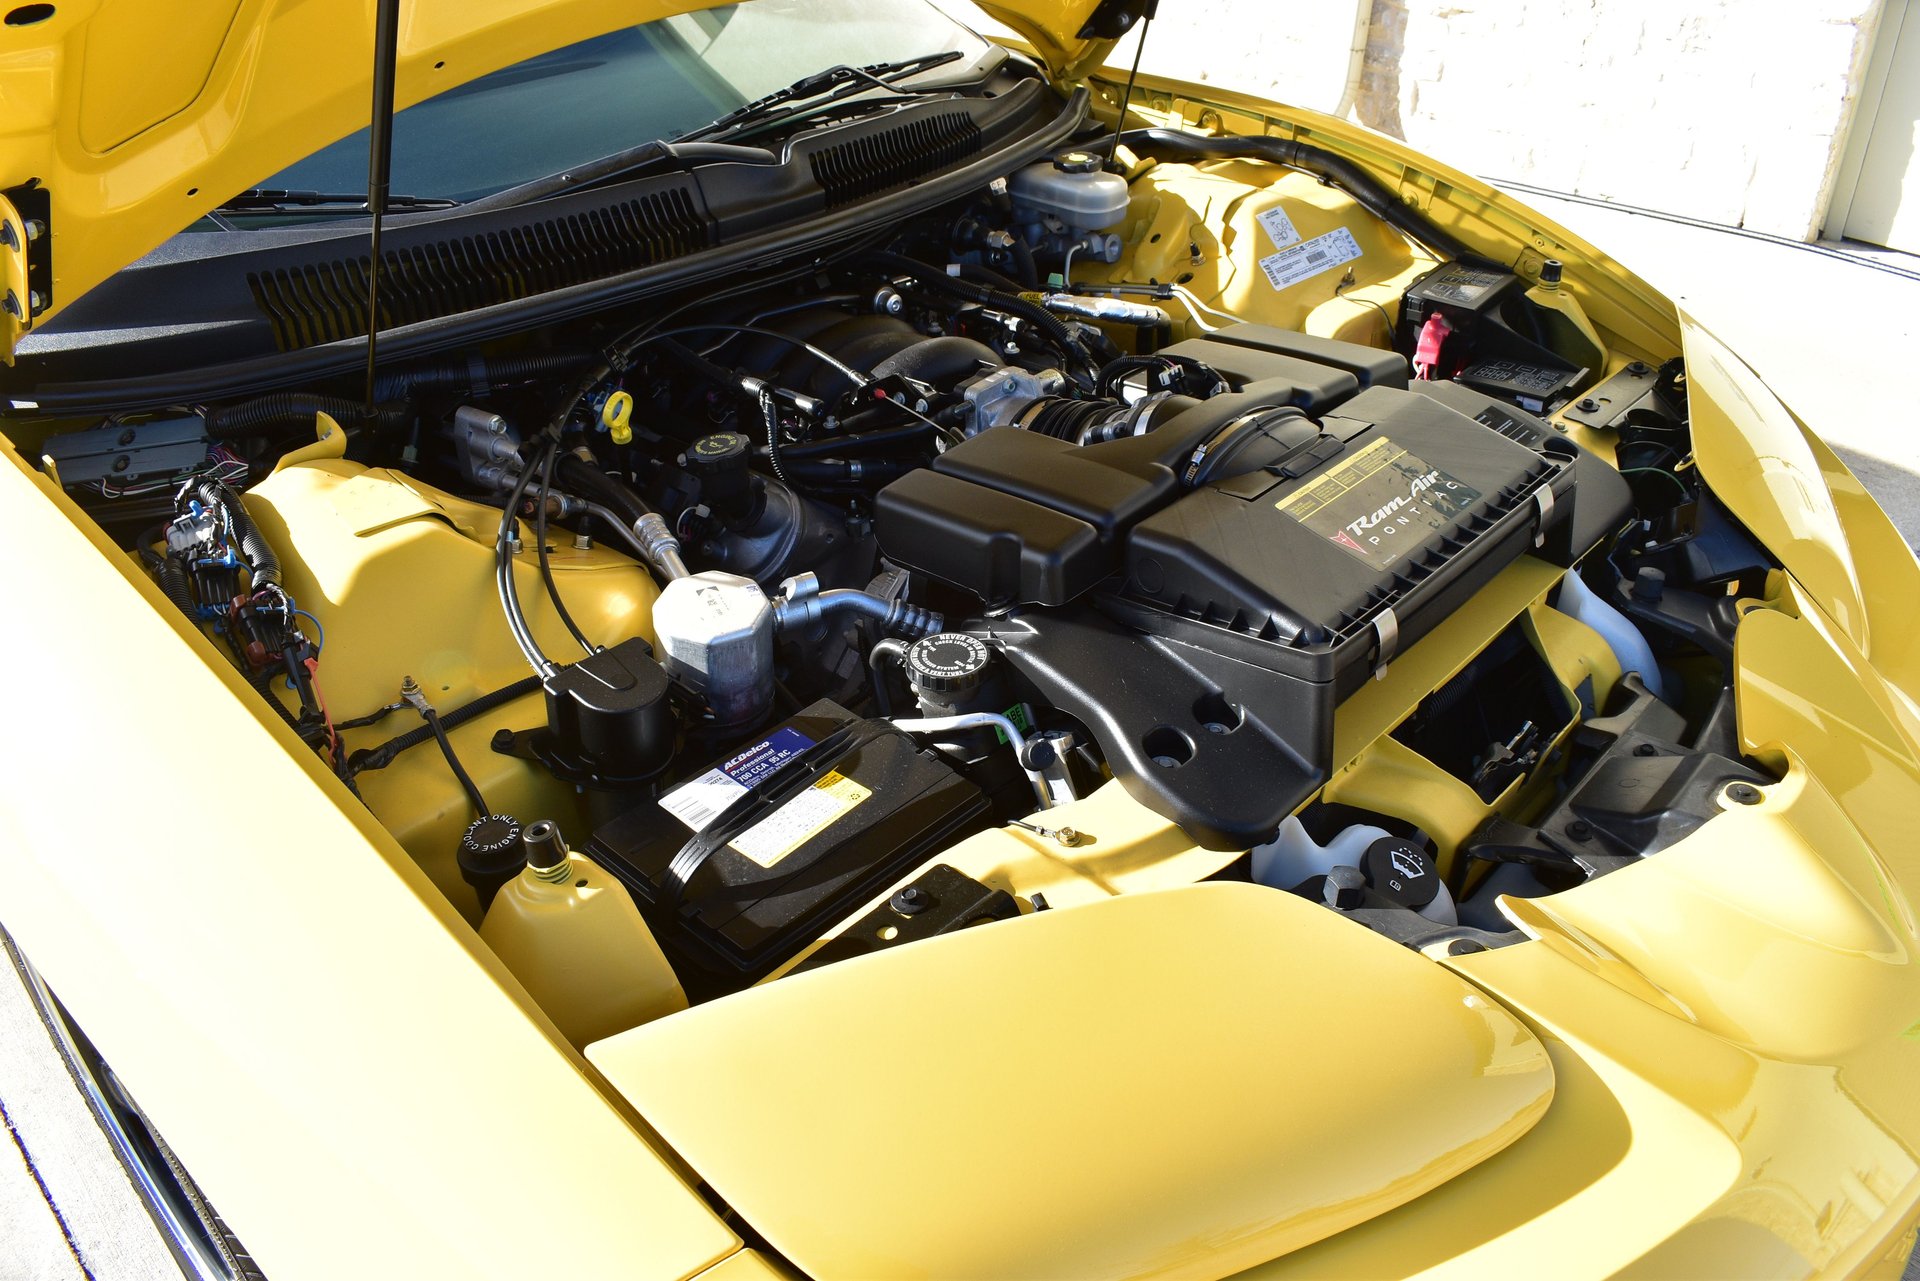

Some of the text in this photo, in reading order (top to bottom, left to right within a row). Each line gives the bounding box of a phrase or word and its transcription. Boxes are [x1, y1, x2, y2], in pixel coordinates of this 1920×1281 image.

[1345, 496, 1412, 536] Ram
[1411, 470, 1440, 497] Air
[1368, 481, 1458, 545] PONTIAC
[939, 633, 966, 641] NEVER
[724, 741, 770, 771] ACDelco
[730, 748, 775, 776] Professional
[736, 771, 753, 782] 700
[750, 762, 769, 774] CCA
[768, 755, 780, 764] 95
[777, 749, 791, 759] RC
[463, 814, 519, 852] ENGINE COOLANT ONLY
